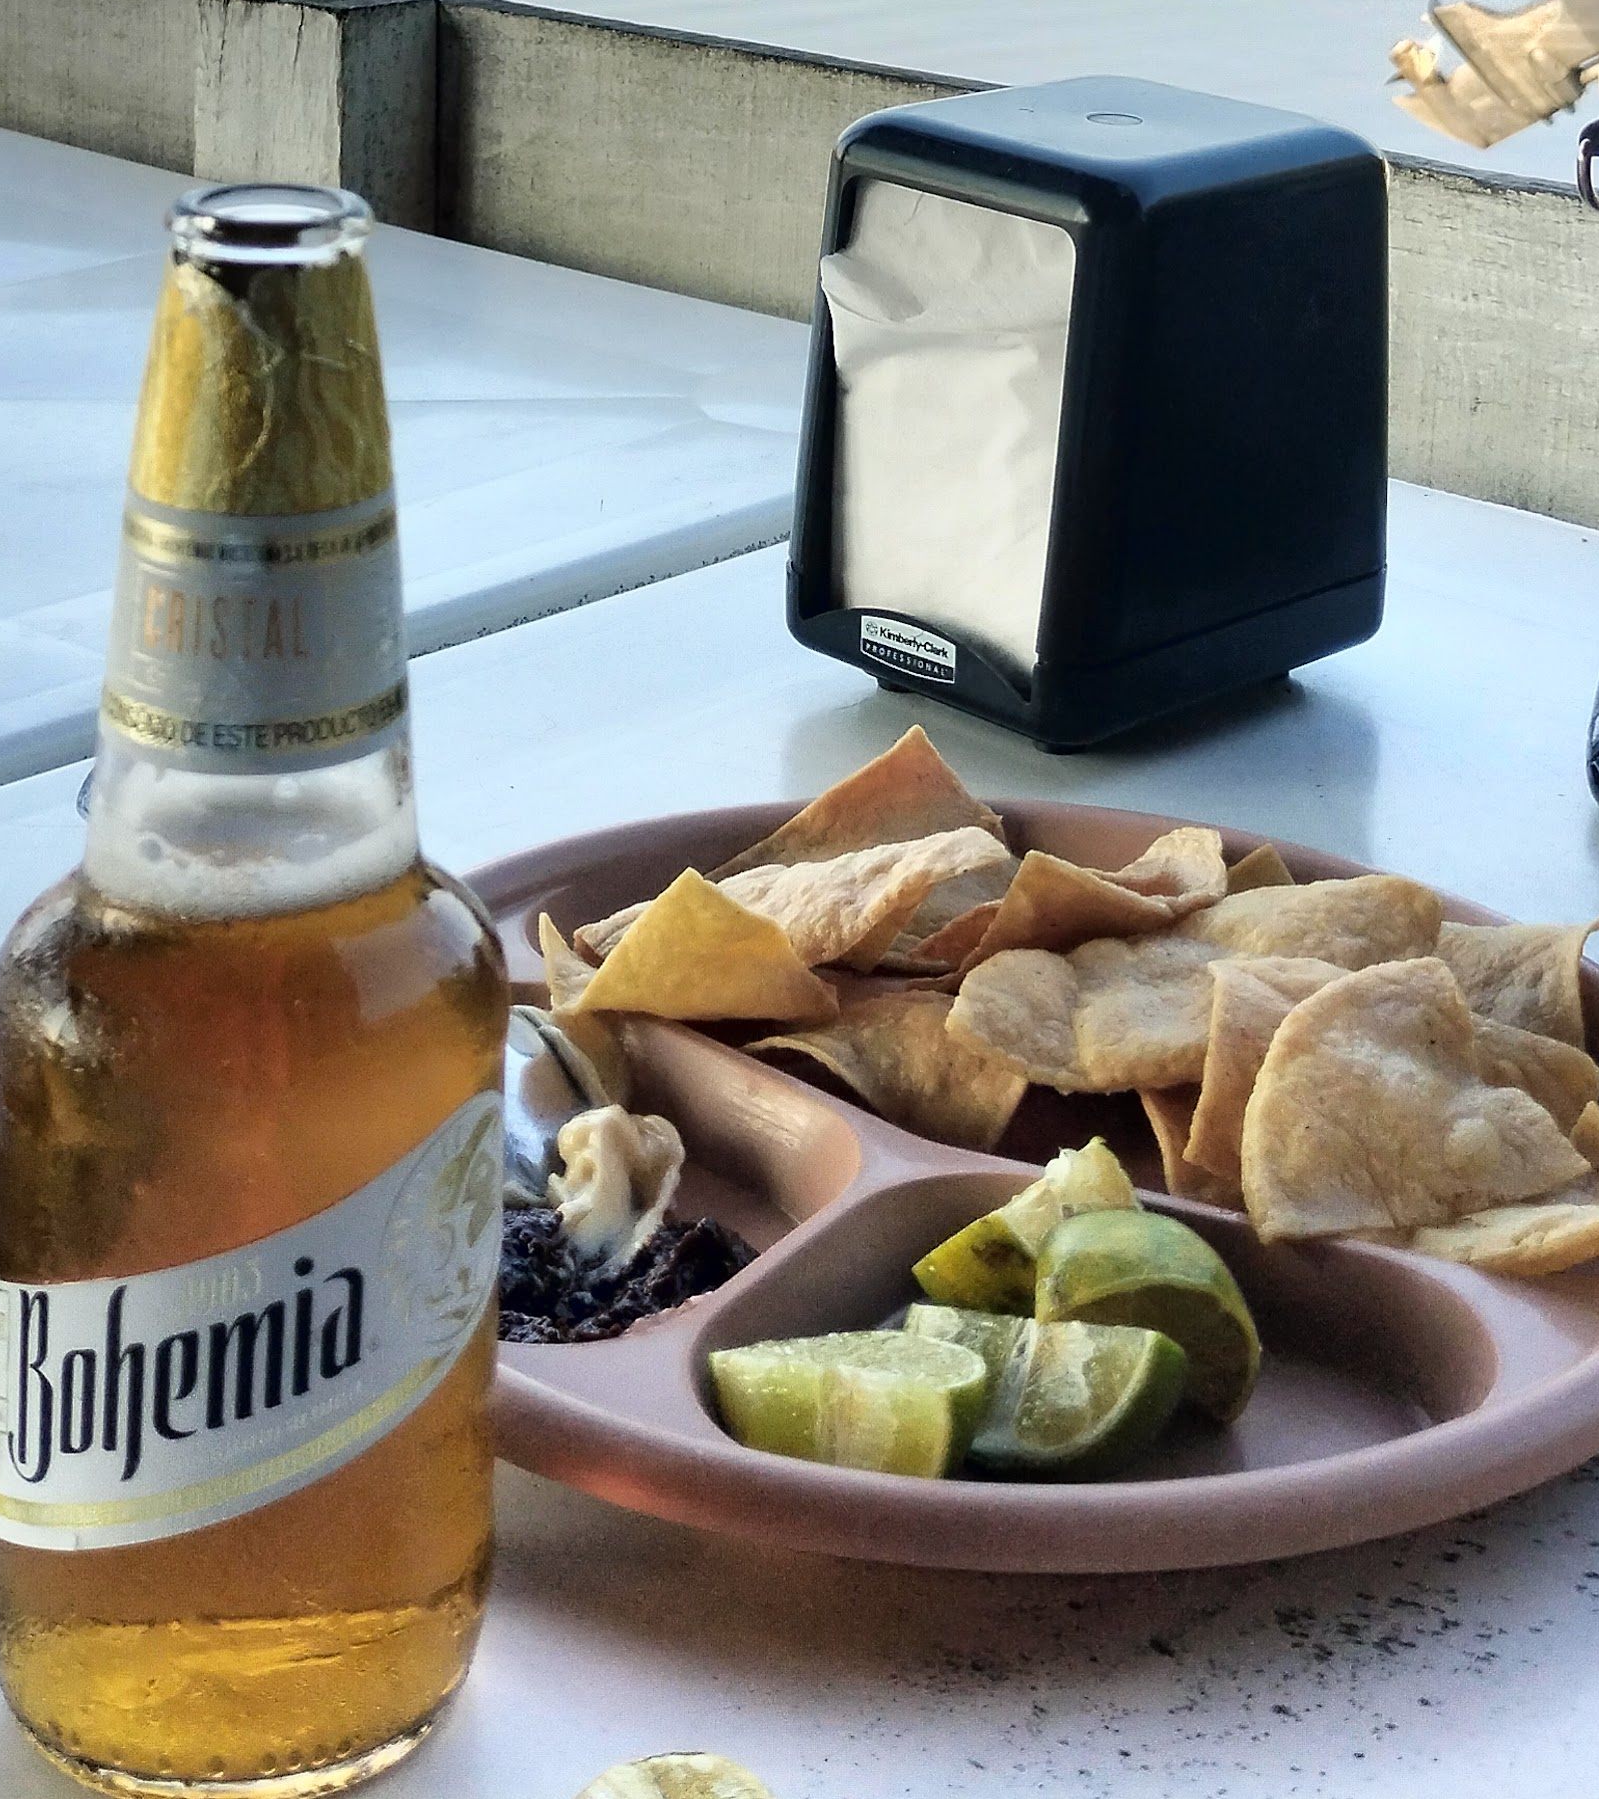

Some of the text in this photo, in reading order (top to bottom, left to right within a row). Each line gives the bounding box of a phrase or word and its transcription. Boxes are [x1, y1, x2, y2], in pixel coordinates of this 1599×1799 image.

[865, 642, 947, 677] PROFESSIONAL
[879, 626, 949, 659] Kimberly-Clark
[8, 1255, 366, 1484] Bohemia
